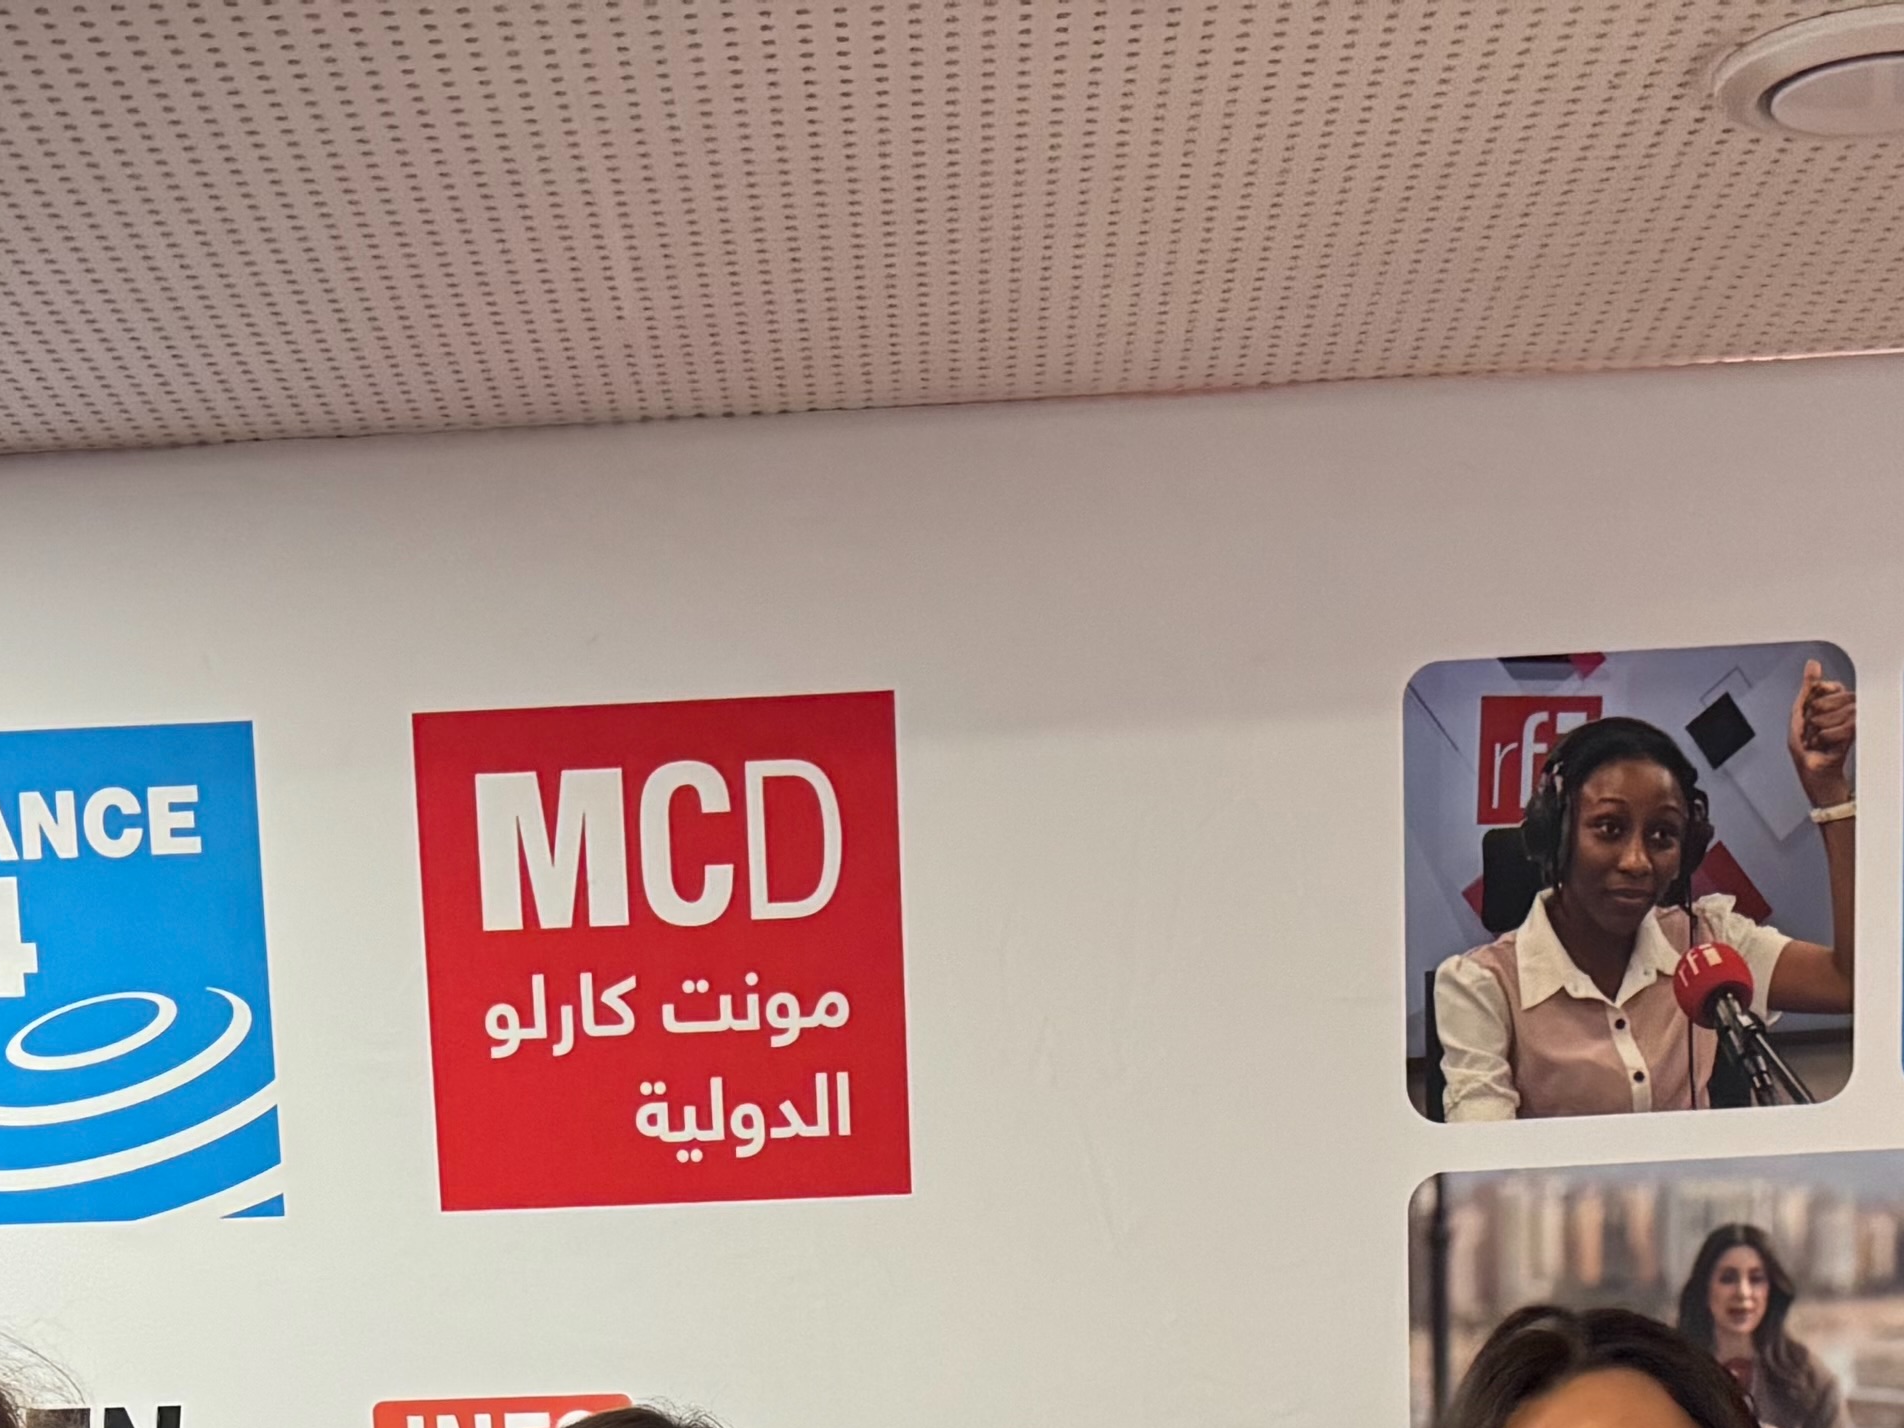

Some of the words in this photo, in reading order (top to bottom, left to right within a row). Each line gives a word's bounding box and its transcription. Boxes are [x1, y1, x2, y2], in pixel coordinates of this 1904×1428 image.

[1492, 711, 1587, 809] rf
[474, 759, 842, 931] MCD
[484, 972, 637, 1059] كارلو
[661, 972, 850, 1048] مونت
[635, 1071, 852, 1163] الدولية
